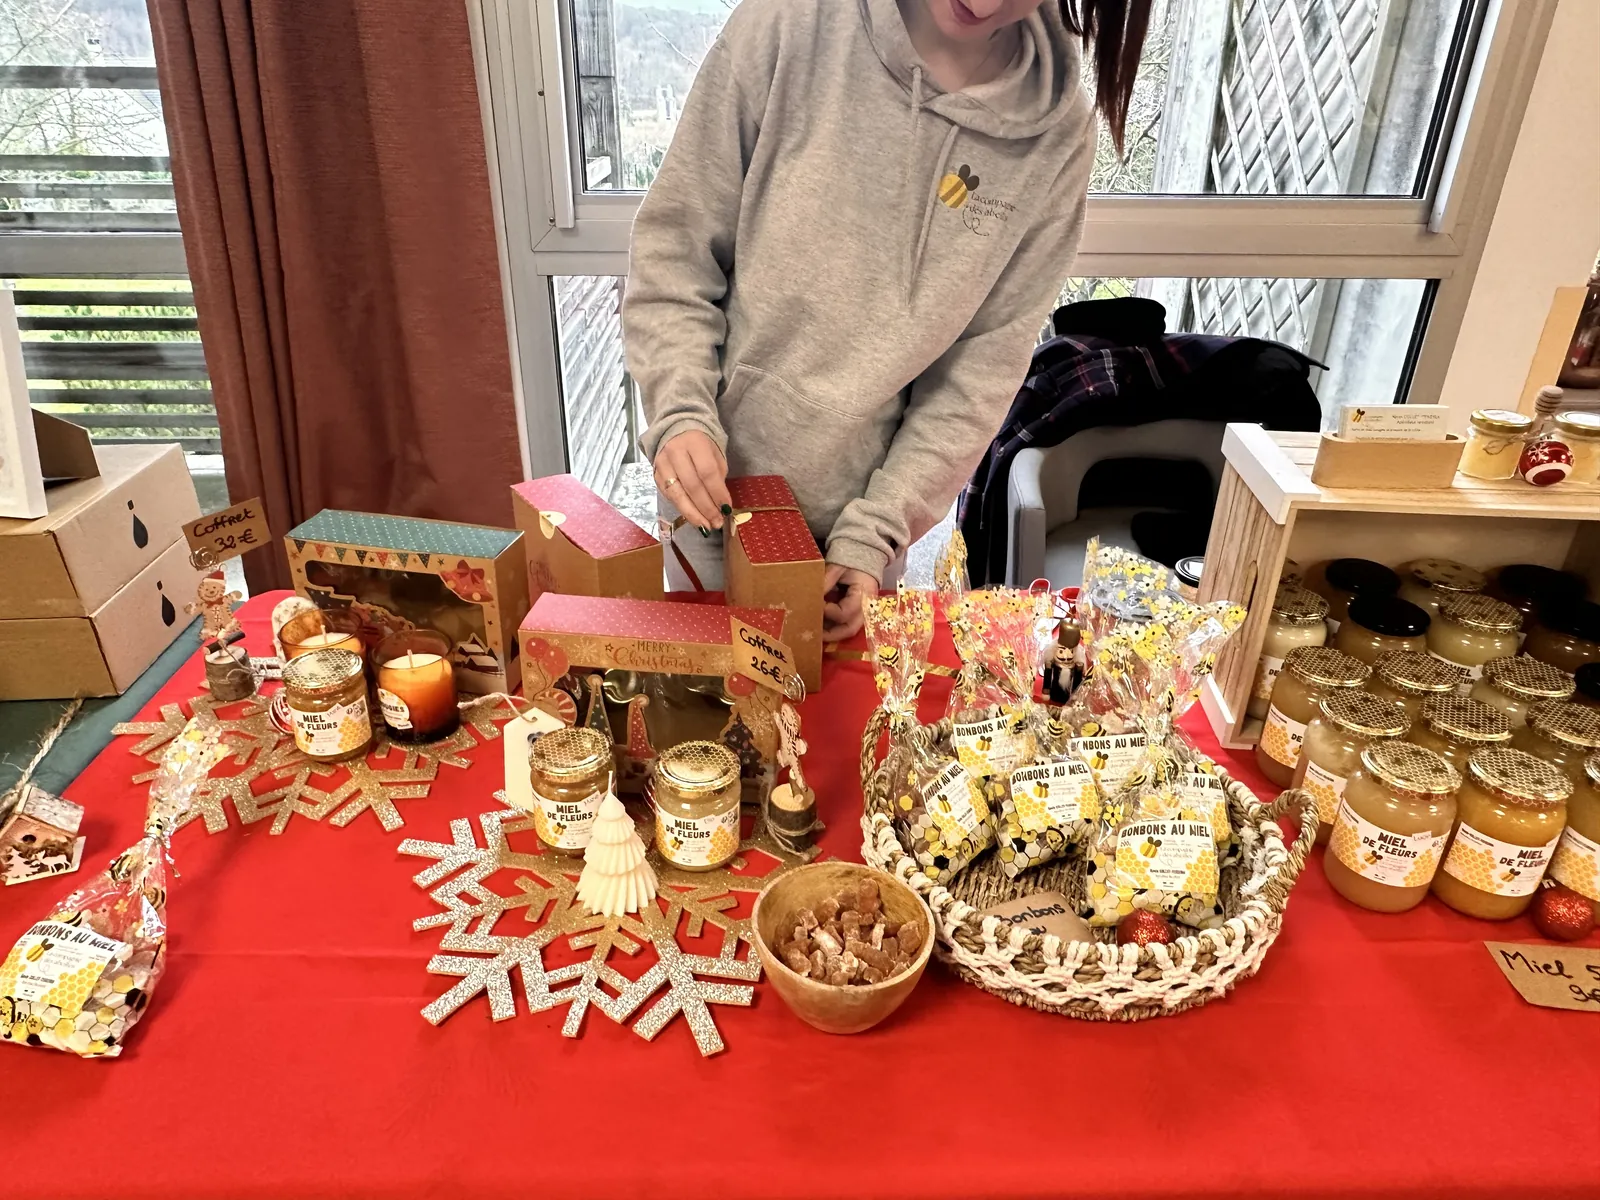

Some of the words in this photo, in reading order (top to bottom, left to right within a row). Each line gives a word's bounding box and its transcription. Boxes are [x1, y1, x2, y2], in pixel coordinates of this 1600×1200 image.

[194, 508, 255, 537] Coffret
[637, 640, 672, 653] MERRY
[739, 627, 788, 664] Coffret
[606, 646, 696, 674] Christmas
[751, 656, 782, 684] 26€
[302, 714, 326, 723] MIEL
[307, 721, 338, 731] FLEURS
[956, 723, 994, 737] BONBONS
[1115, 738, 1127, 749] AU
[1129, 737, 1146, 748] MIE
[1291, 733, 1302, 743] DE
[940, 773, 951, 787] AU
[947, 764, 964, 779] MIEL
[1012, 768, 1050, 785] BONBONS
[1053, 766, 1066, 778] AU
[1068, 764, 1088, 776] MIEL
[1193, 777, 1206, 789] AU
[556, 804, 581, 814] MIEL
[547, 811, 558, 820] DE
[560, 811, 593, 822] FLEURS
[666, 824, 675, 835] DE
[677, 829, 711, 839] FLEURS
[674, 819, 699, 831] MIEL
[1121, 824, 1167, 838] BONBONS
[1171, 824, 1185, 835] AU
[1189, 824, 1210, 838] MIEL
[1362, 836, 1377, 848] DE
[1378, 843, 1418, 859] FLEURS
[1377, 832, 1407, 849] MIEL
[1517, 849, 1543, 860] MIEL
[1499, 857, 1513, 867] DE
[70, 932, 91, 944] AU
[89, 938, 116, 952] MIEL
[1499, 950, 1574, 979] Miel
